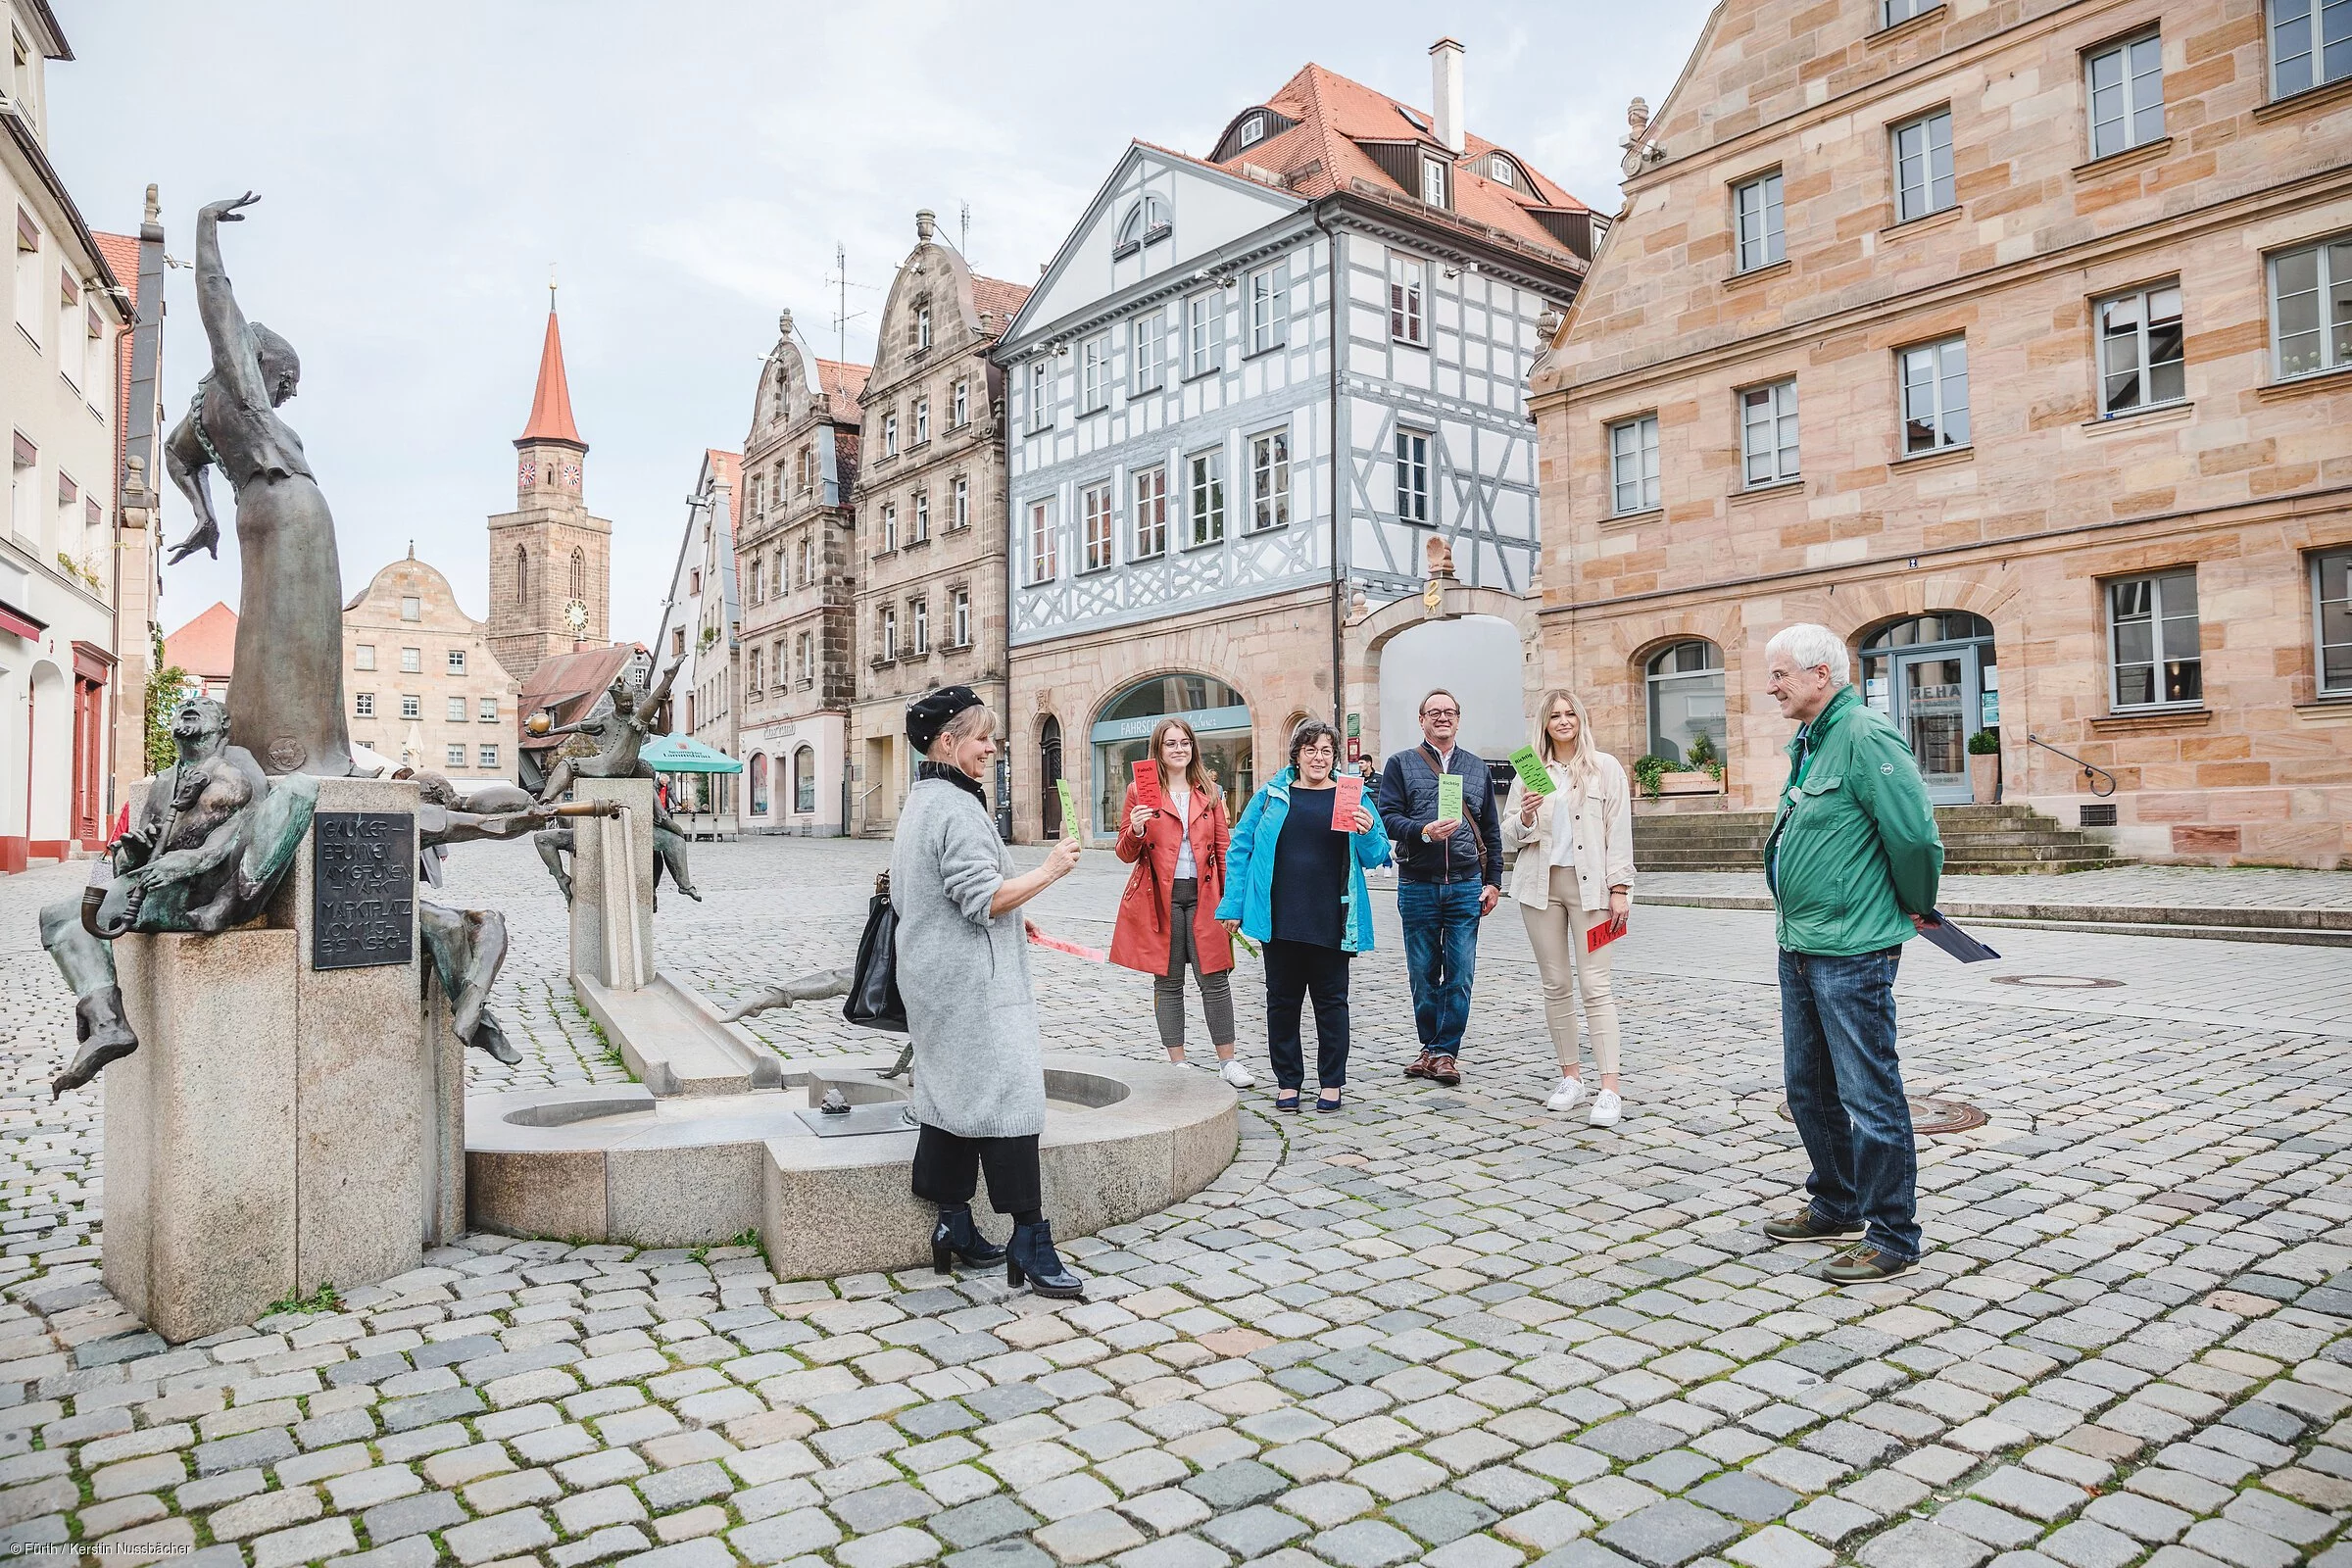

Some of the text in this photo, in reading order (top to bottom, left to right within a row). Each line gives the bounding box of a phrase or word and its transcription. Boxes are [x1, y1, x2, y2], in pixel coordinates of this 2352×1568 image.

[1910, 685, 1960, 700] REHA
[1120, 719, 1160, 736] FAHRSCH
[1514, 753, 1533, 764] Richtig
[324, 842, 391, 859] BRUNNEN
[323, 865, 348, 880] AM
[322, 899, 412, 918] MARKTPLATZ
[321, 922, 354, 936] VOM
[321, 938, 347, 954] BIS
